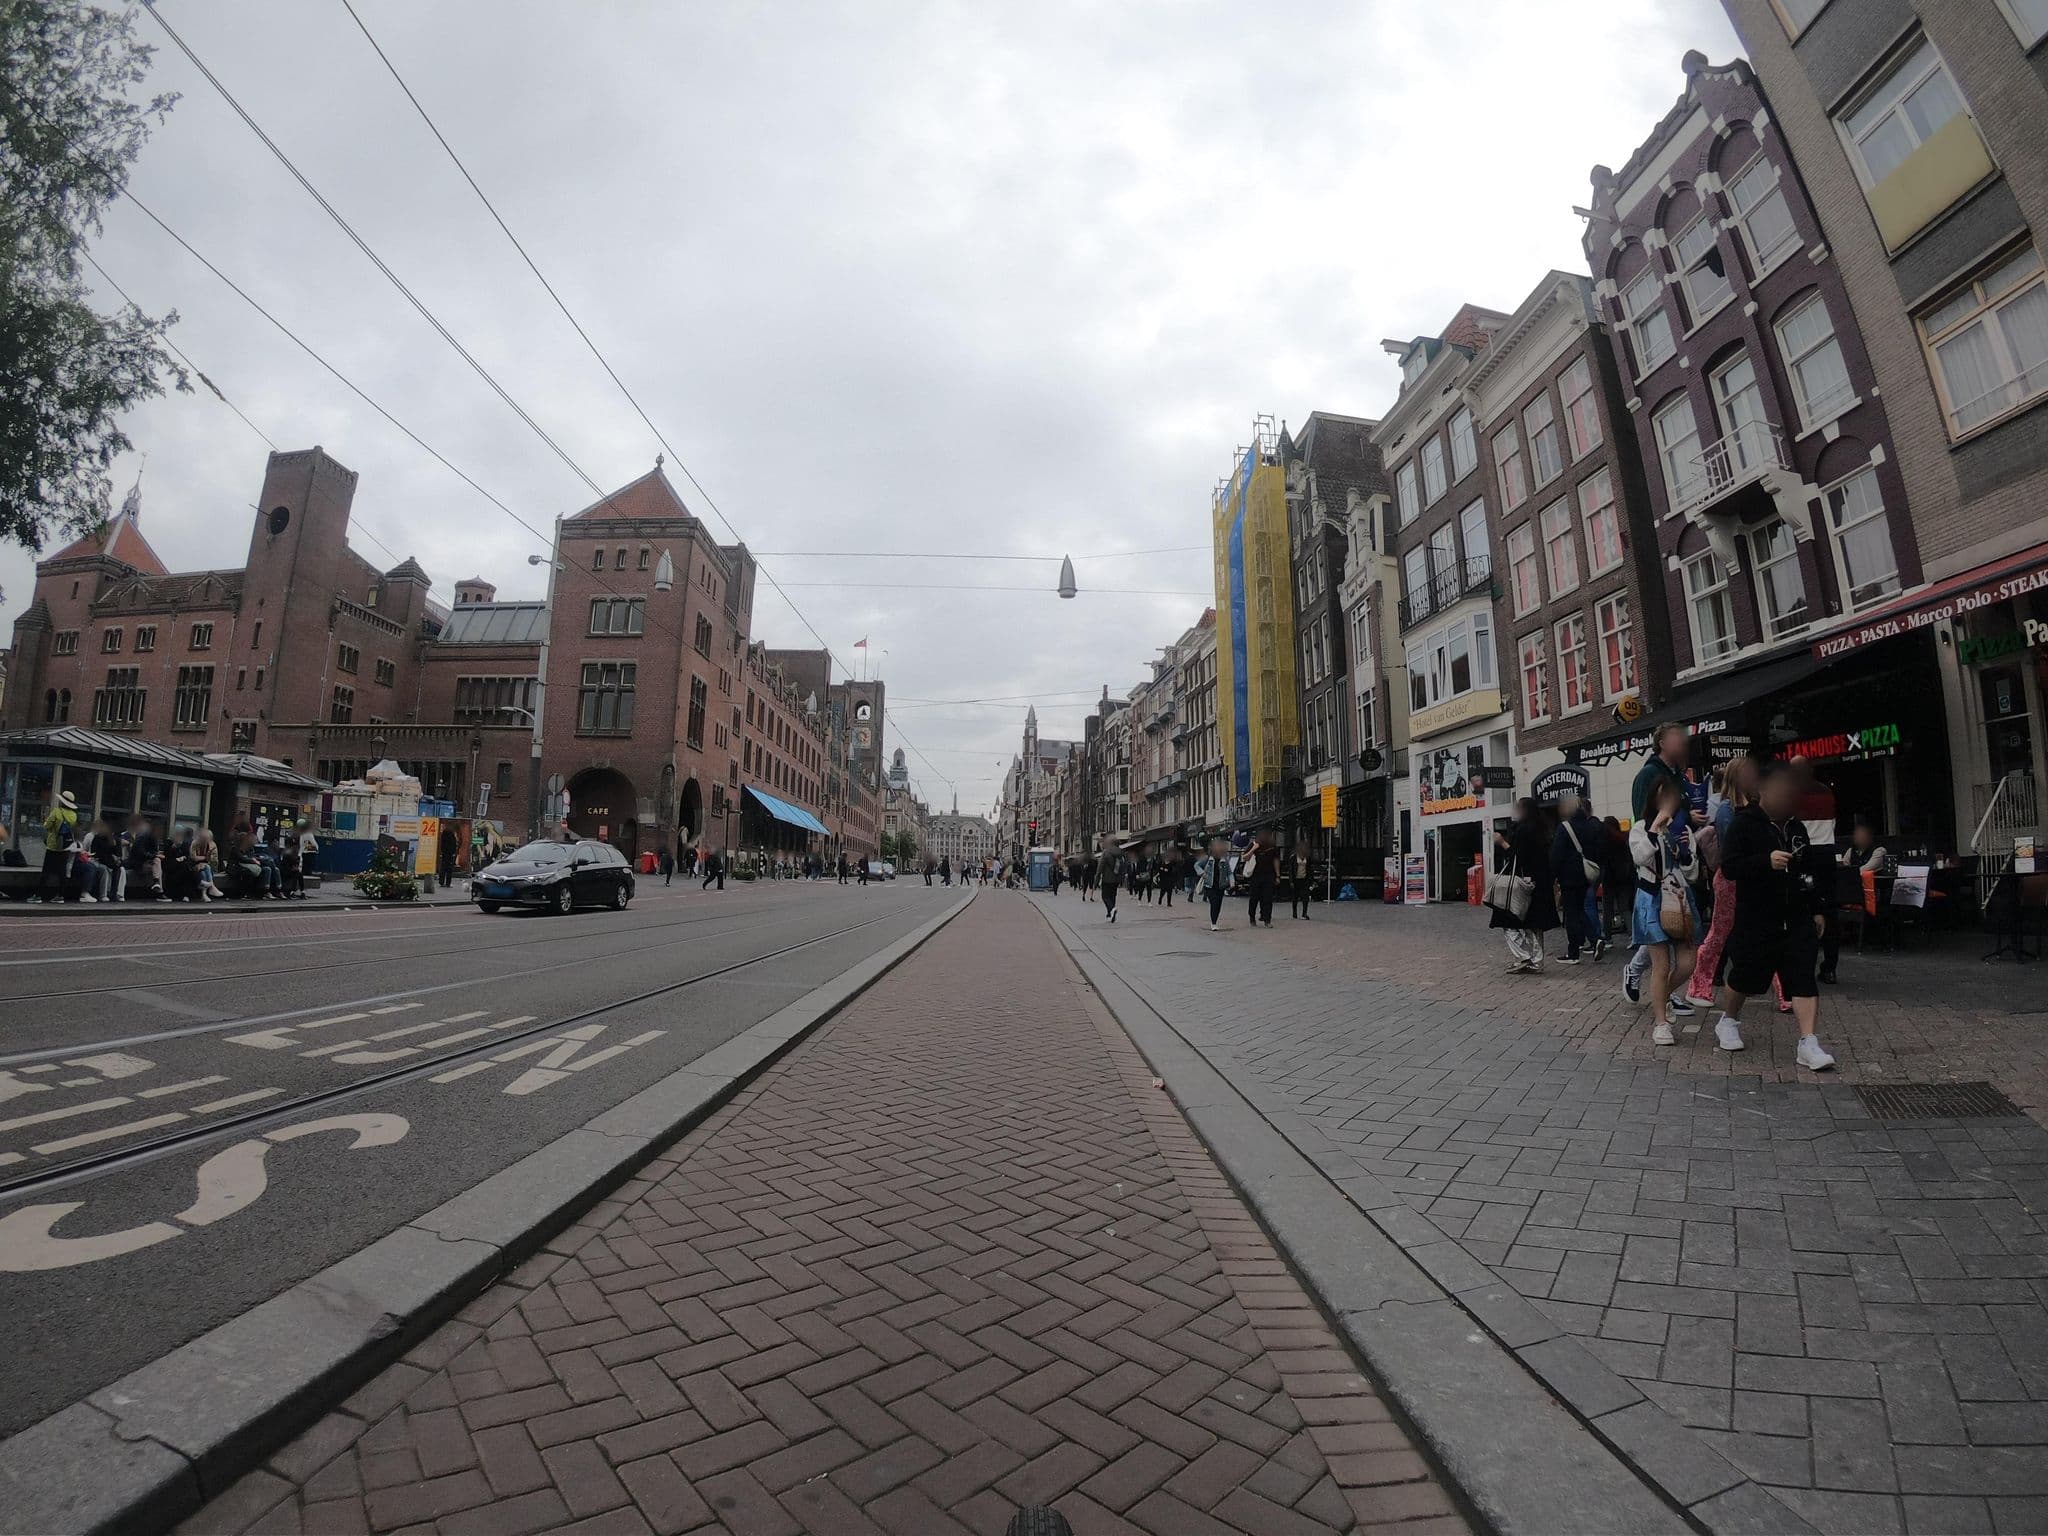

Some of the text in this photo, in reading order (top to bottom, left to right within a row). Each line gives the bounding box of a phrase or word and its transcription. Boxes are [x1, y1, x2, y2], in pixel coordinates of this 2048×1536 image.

[1819, 635, 1856, 658] PIZZA
[1860, 620, 1900, 644] PASTA
[1907, 606, 1953, 630] Marco
[1956, 590, 1992, 614] Polo
[1580, 743, 1618, 759] Breakfast
[1697, 720, 1726, 734] Pizza
[1861, 723, 1900, 748] PIZZA
[1536, 771, 1585, 796] AMSTERDAM
[1542, 791, 1549, 800] IS
[1549, 789, 1559, 800] MY
[587, 807, 609, 815] CAFE
[421, 820, 436, 837] 24
